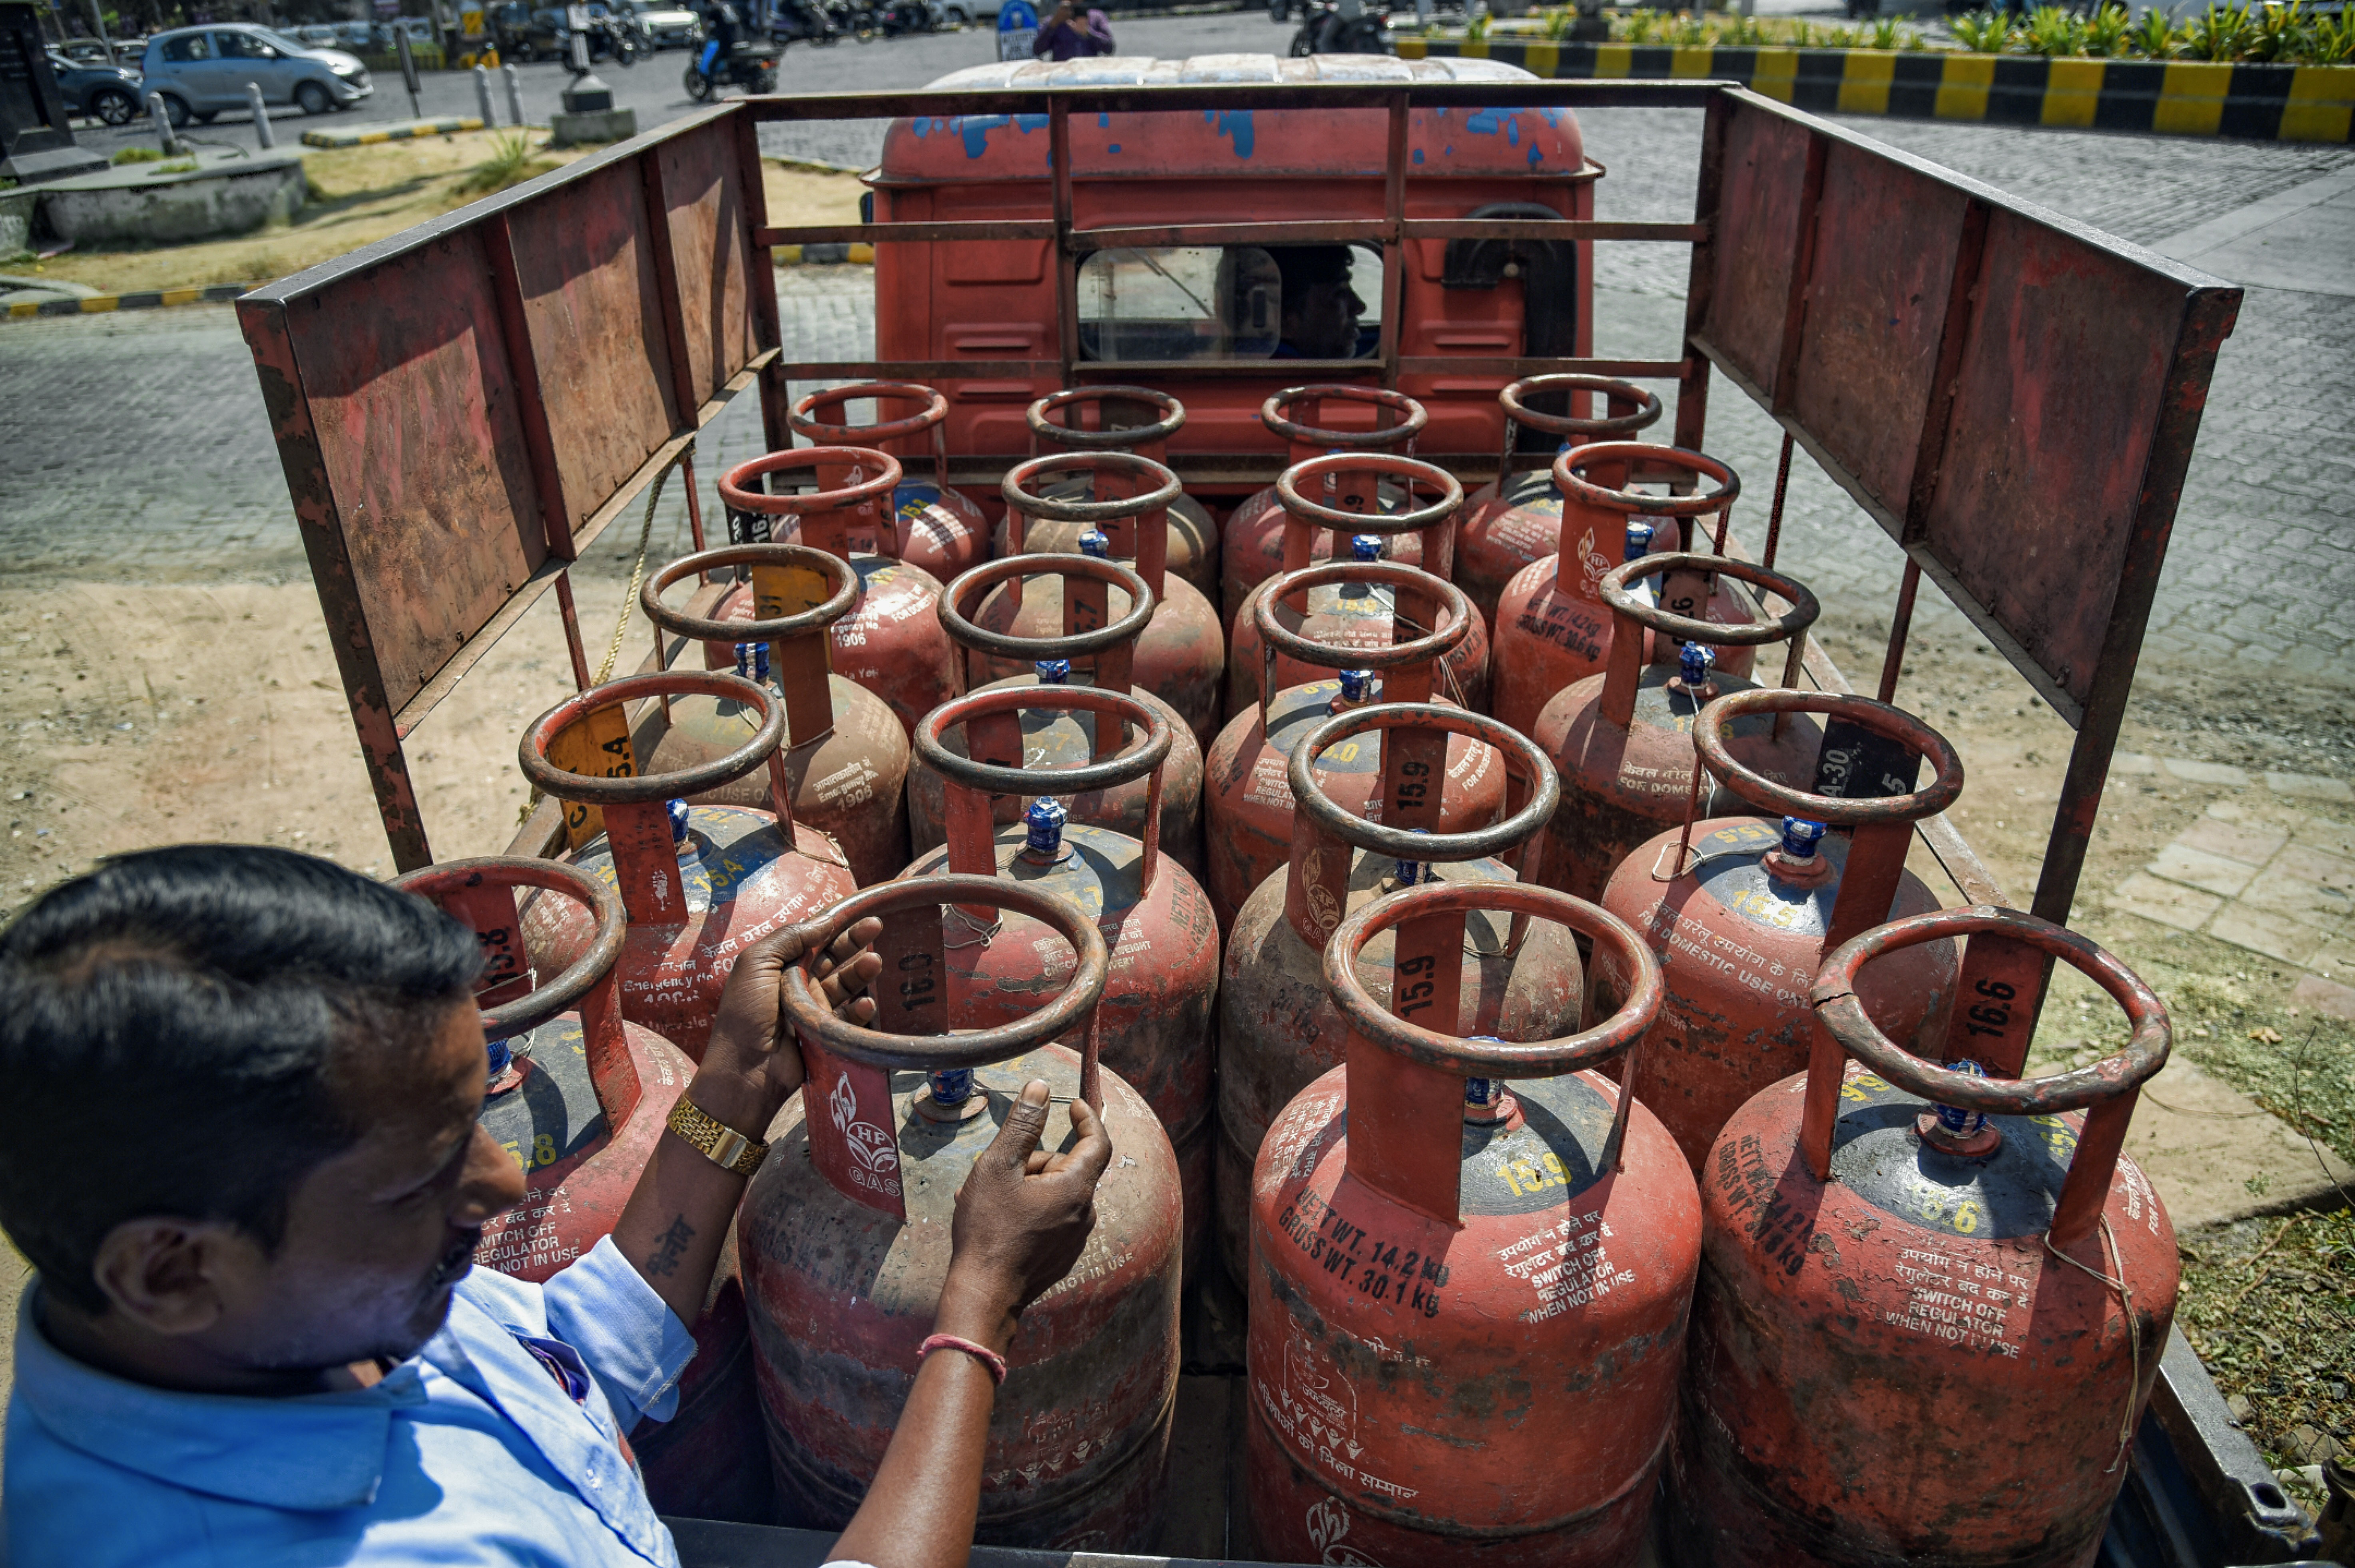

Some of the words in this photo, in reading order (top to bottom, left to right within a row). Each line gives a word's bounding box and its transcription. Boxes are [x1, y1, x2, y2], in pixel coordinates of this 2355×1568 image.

[836, 632, 866, 648] 1906
[754, 786, 793, 801] ONY
[1255, 786, 1295, 801] REGULAT
[1259, 777, 1290, 790] SWITCH
[1397, 761, 1430, 810] 15.9
[1462, 774, 1479, 791] FOR
[1243, 793, 1266, 805] WHEN
[1266, 797, 1284, 806] NOT
[1285, 801, 1296, 810] IN
[692, 858, 745, 893] 15.4
[773, 891, 808, 924] उपयोग
[1731, 889, 1798, 927] 15.5
[478, 927, 520, 987] 15.8
[1638, 909, 1662, 933] FOR
[1660, 928, 1735, 975] DOMESTIC
[1738, 970, 1774, 995] USE
[1776, 988, 1811, 1009] ONL
[1682, 918, 1713, 947] घरेलू
[1713, 935, 1767, 969] उपयोग
[1769, 958, 1786, 976] के
[1792, 967, 1813, 988] लि
[898, 953, 936, 1011] 16.0
[1398, 955, 1436, 1018] 15.9
[1965, 978, 2016, 1038] 16.6
[857, 1126, 887, 1146] HP
[1286, 1100, 1313, 1143] CHECK
[501, 1133, 557, 1170] 5.8
[1716, 1140, 1741, 1191] GROSS
[1740, 1134, 1764, 1168] NETT
[848, 1165, 901, 1198] GAS
[1496, 1152, 1572, 1197] 15.9
[504, 1208, 526, 1224] बंद
[531, 1205, 556, 1219] कर
[1727, 1184, 1754, 1220] WT.
[528, 1221, 556, 1238] OFF
[1295, 1185, 1337, 1229] NETT
[1330, 1217, 1368, 1255] WT.
[1371, 1240, 1420, 1277] 14.2
[1419, 1255, 1450, 1288] kg
[1496, 1236, 1543, 1262] उपयोग
[1543, 1226, 1557, 1241] न
[1582, 1208, 1604, 1226] पर
[473, 1236, 560, 1265] REGULATOR
[499, 1256, 530, 1274] NOT
[533, 1252, 549, 1267] IN
[551, 1246, 580, 1263] USE
[1278, 1205, 1327, 1260] GROSS
[1323, 1246, 1358, 1285] WT.
[1359, 1269, 1409, 1305] 30.1
[1411, 1282, 1440, 1318] kg
[1503, 1250, 1556, 1279] रेगुलेटर
[1531, 1258, 1581, 1289] SWITCH
[1582, 1246, 1609, 1268] OFF
[1777, 1242, 1805, 1276] kg
[1900, 1247, 1950, 1269] उपयोग
[1955, 1259, 1969, 1274] न
[1974, 1262, 2004, 1285] होने
[2008, 1274, 2030, 1290] पर
[1056, 1273, 1086, 1295] NOT
[1088, 1264, 1106, 1281] IN
[1108, 1252, 1135, 1272] USE
[1536, 1261, 1615, 1301] REGULATOR
[1894, 1261, 1951, 1289] रेगुलेटर
[1957, 1277, 1980, 1297] बंद
[1985, 1287, 2012, 1301] कर
[1527, 1299, 1568, 1324] WHEN
[1568, 1286, 1596, 1309] NOT
[1596, 1280, 1612, 1297] IN
[1611, 1268, 1636, 1287] USE
[1912, 1287, 1973, 1313] SWITCH
[1975, 1301, 2007, 1320] OFF
[1885, 1311, 1931, 1334] WHEN
[1934, 1323, 1967, 1343] NOT
[1909, 1301, 2005, 1338] REGULATOR
[1297, 1430, 1315, 1453] को
[1319, 1445, 1356, 1480] मिला
[1359, 1470, 1419, 1499] सम्मान
